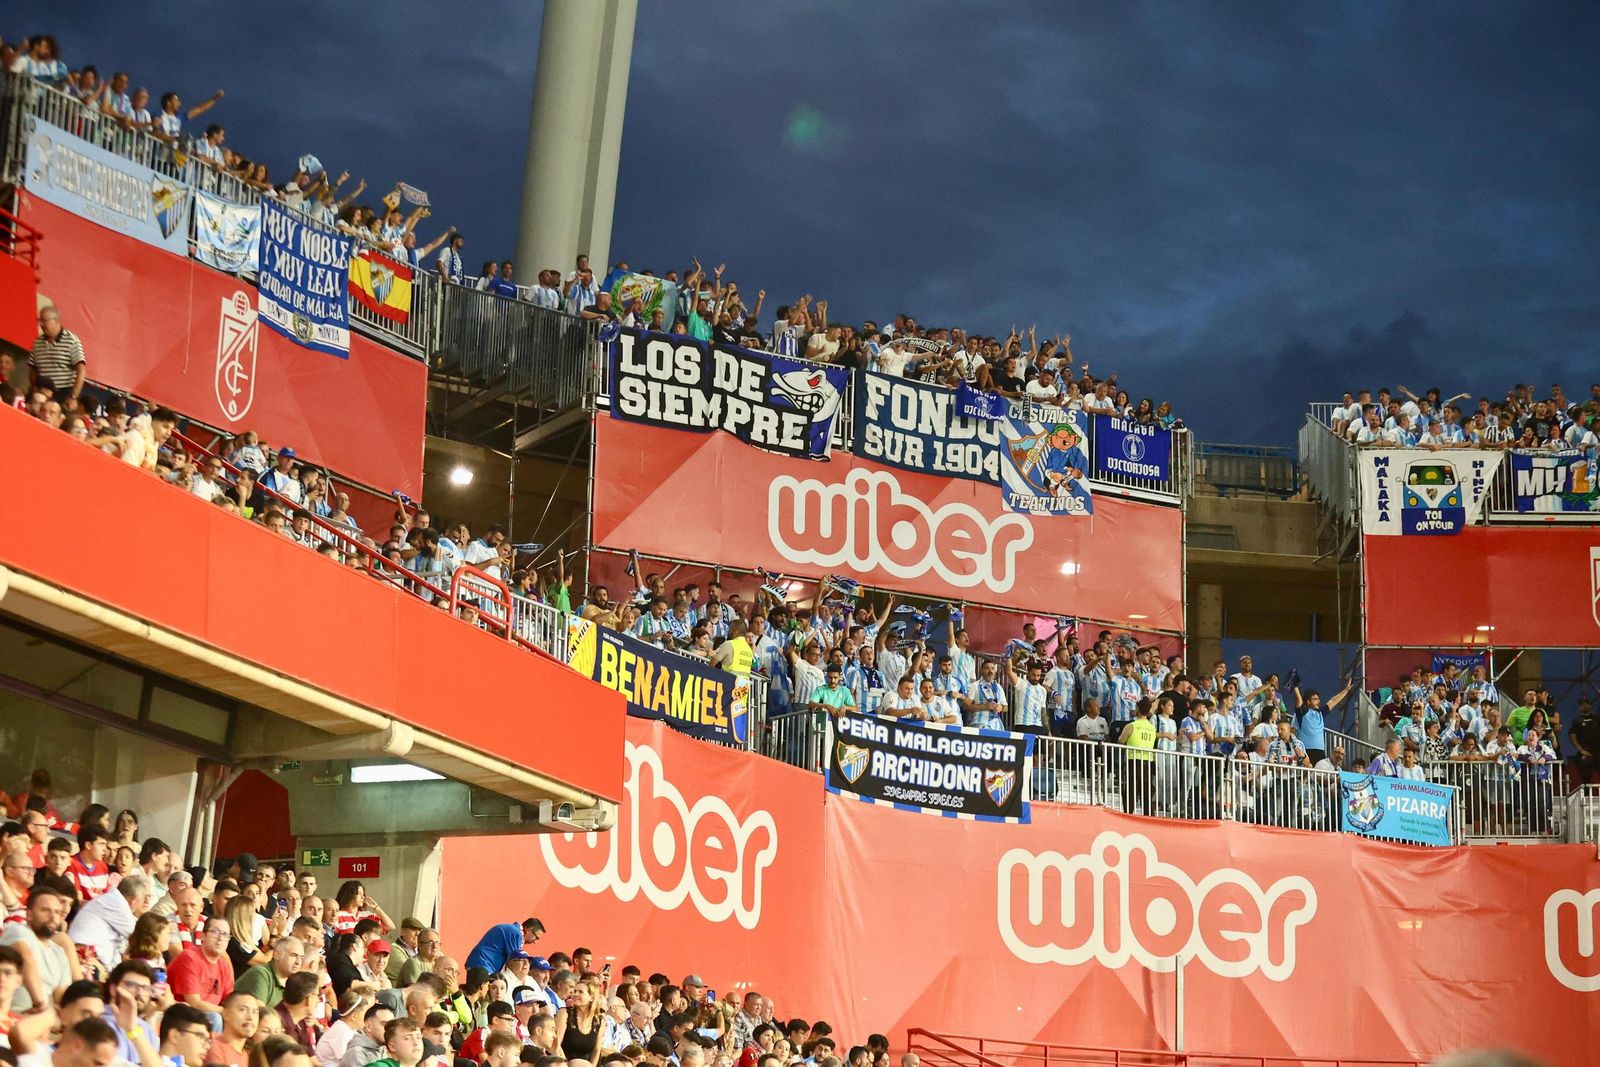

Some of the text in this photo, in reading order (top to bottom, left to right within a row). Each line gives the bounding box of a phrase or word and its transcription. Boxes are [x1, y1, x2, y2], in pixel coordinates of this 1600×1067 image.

[263, 202, 350, 270] MUY NOBLE
[260, 271, 292, 305] CIUDAD
[293, 291, 306, 311] DE
[263, 237, 274, 265] Y
[274, 245, 304, 288] MUY
[308, 265, 342, 298] LEAL
[619, 333, 766, 403] LOS DE
[619, 375, 808, 450] SIEMPRE
[864, 423, 925, 470] SUR
[932, 440, 999, 482] 1904
[1009, 493, 1085, 512] TEATINOS
[1374, 456, 1390, 522] MALAKA
[1425, 510, 1442, 520] TOI
[768, 467, 1034, 593] wiber
[600, 639, 728, 728] BENAMIEL
[837, 716, 888, 744] PEÑA
[894, 728, 1017, 763] MALAGUISTA
[870, 749, 983, 794] ARCHIDONA
[1408, 784, 1446, 799] MALAGUISTA
[1387, 795, 1446, 819] PIZARRA
[351, 863, 367, 872] 101
[997, 831, 1318, 981] wiber
